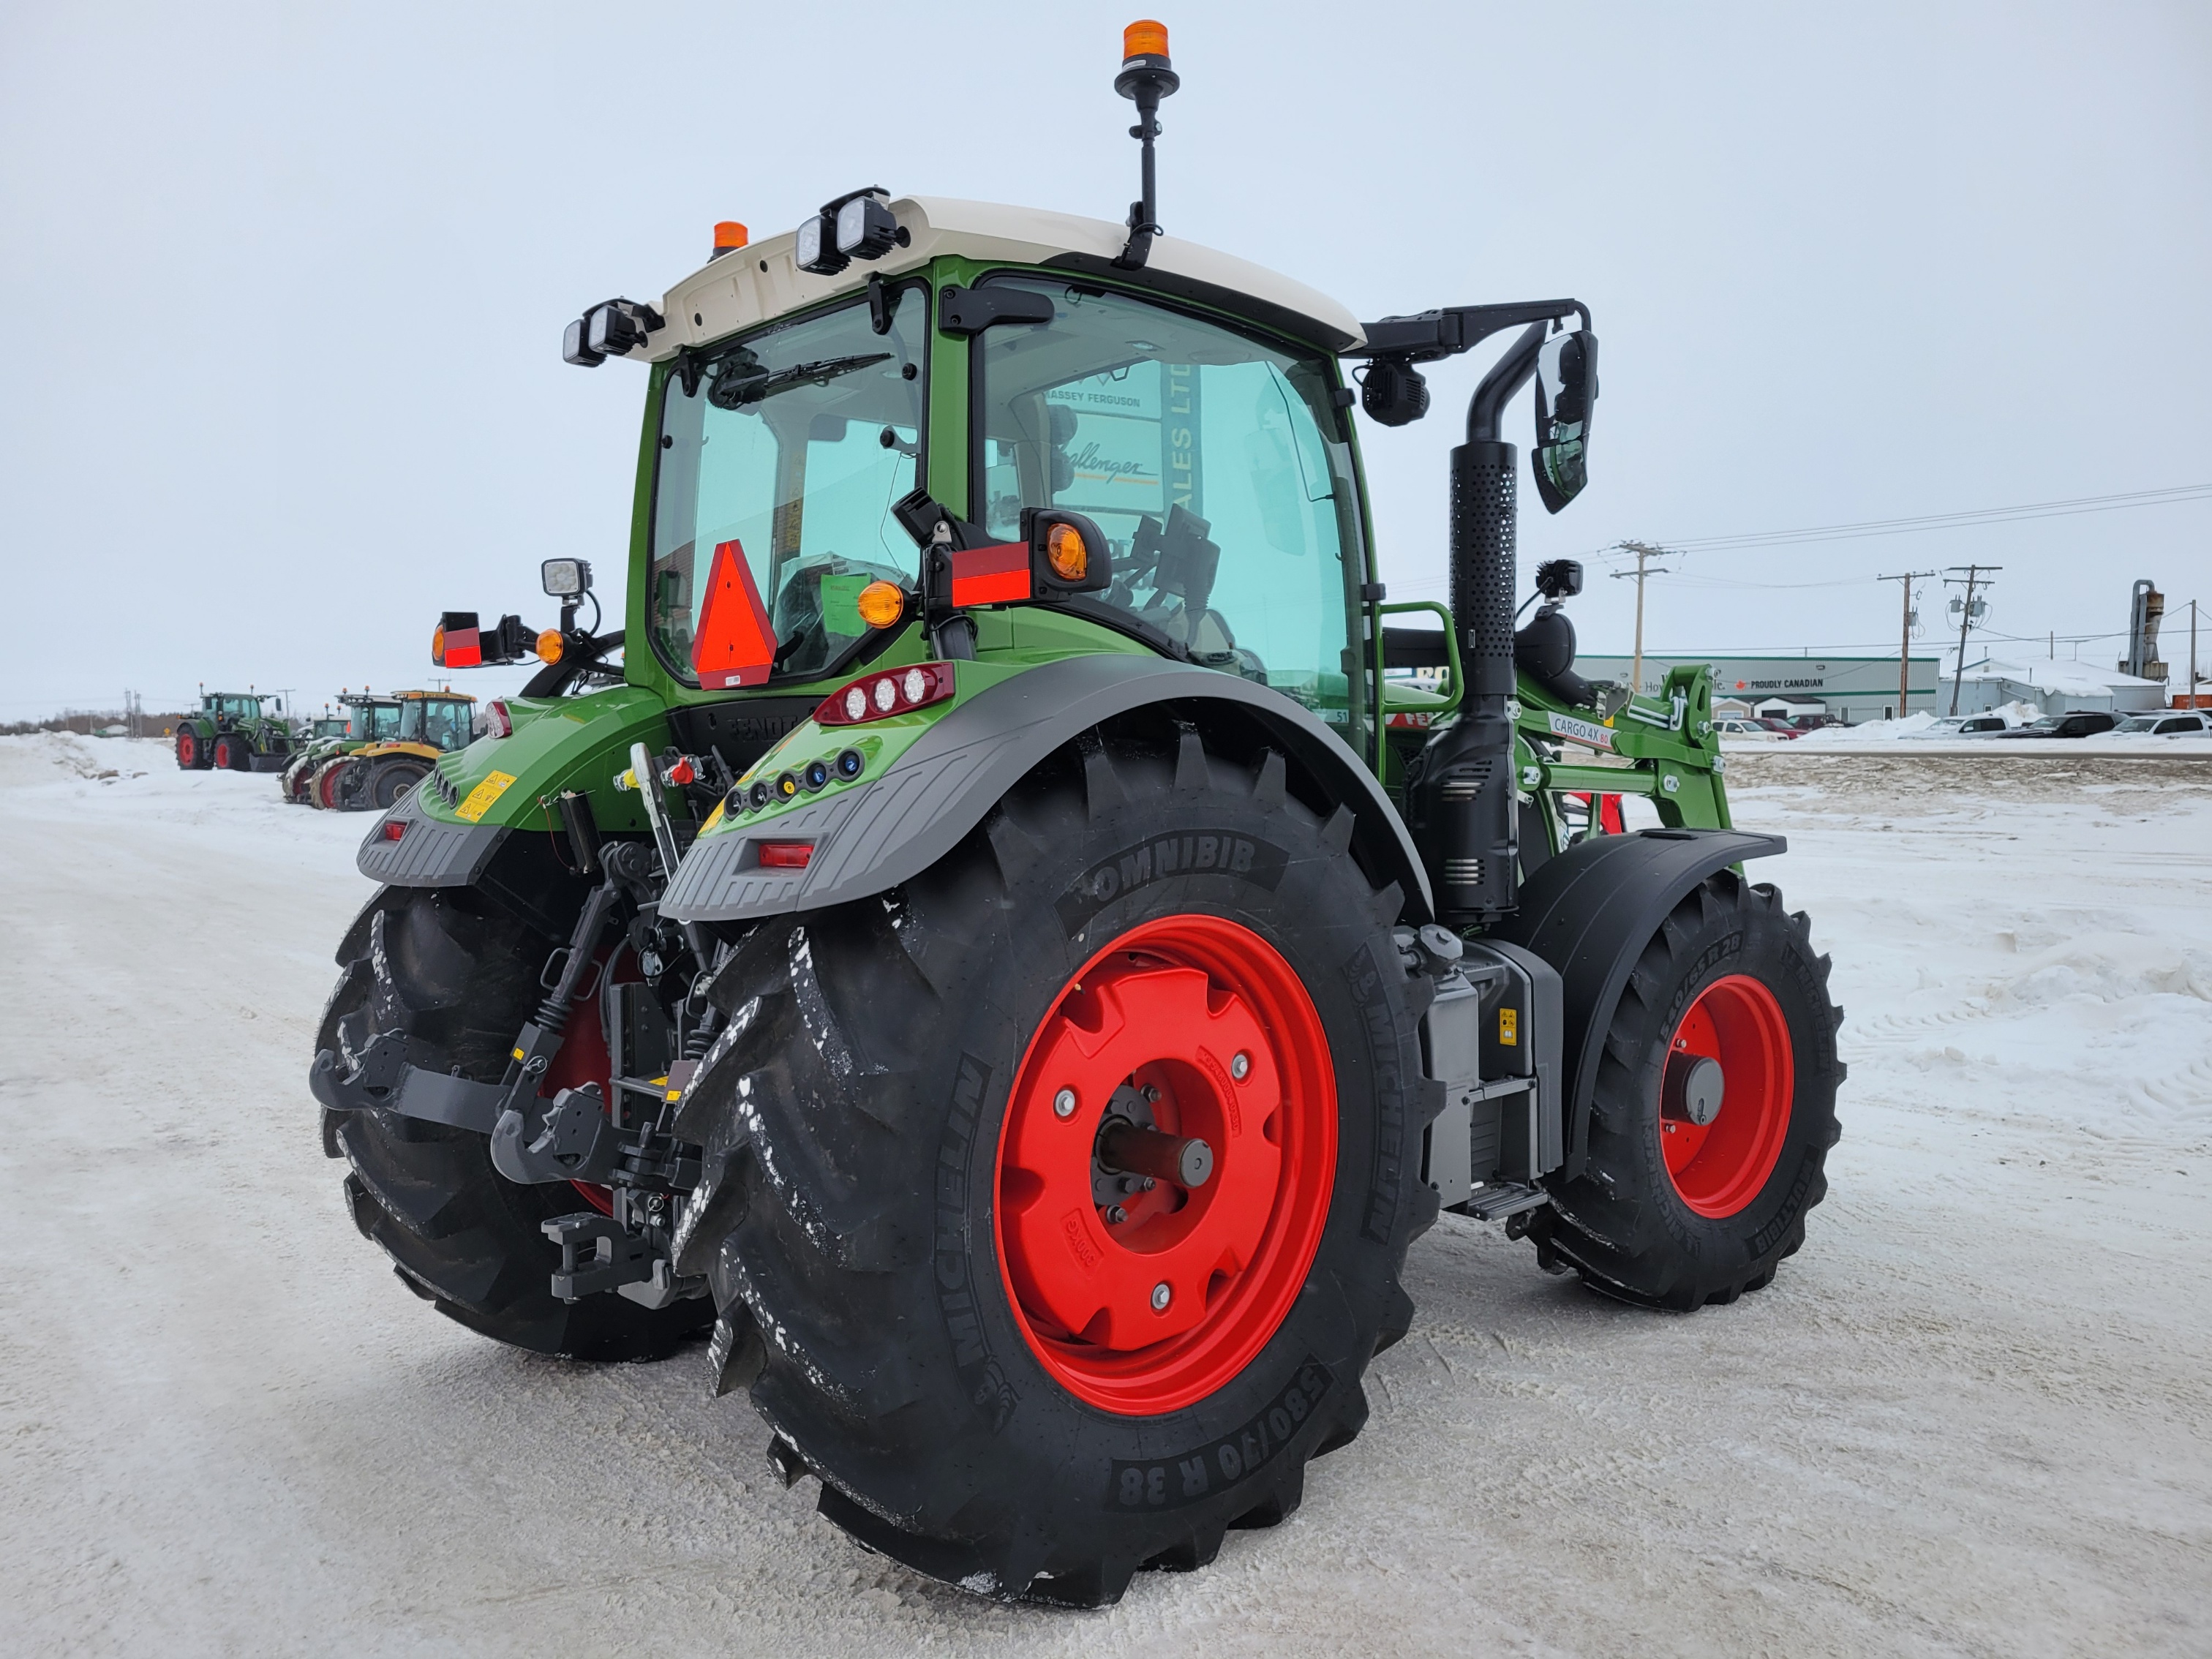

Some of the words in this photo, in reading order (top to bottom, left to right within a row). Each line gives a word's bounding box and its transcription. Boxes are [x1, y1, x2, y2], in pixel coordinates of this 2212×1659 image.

[1088, 393, 1140, 407] FERGUSON
[1069, 442, 1159, 484] allenger
[1172, 428, 1192, 511] ALES
[1751, 680, 1782, 689] PROUDLY
[1784, 679, 1824, 688] CANADIAN
[726, 715, 797, 742] FENDT
[1554, 718, 1586, 738] CARGO
[1588, 728, 1599, 742] 4X
[1600, 734, 1609, 744] 80
[1095, 836, 1255, 902] OMNIBIB
[1722, 933, 1742, 954] 28
[1363, 1002, 1402, 1243] MICHELIN
[935, 1054, 984, 1368] MICHELIN
[1757, 1159, 1816, 1253] MULTIBIB
[1068, 1218, 1094, 1265] 300KG
[1219, 1367, 1324, 1481] 580/70
[1118, 1467, 1166, 1505] 38
[1179, 1456, 1208, 1497] R
